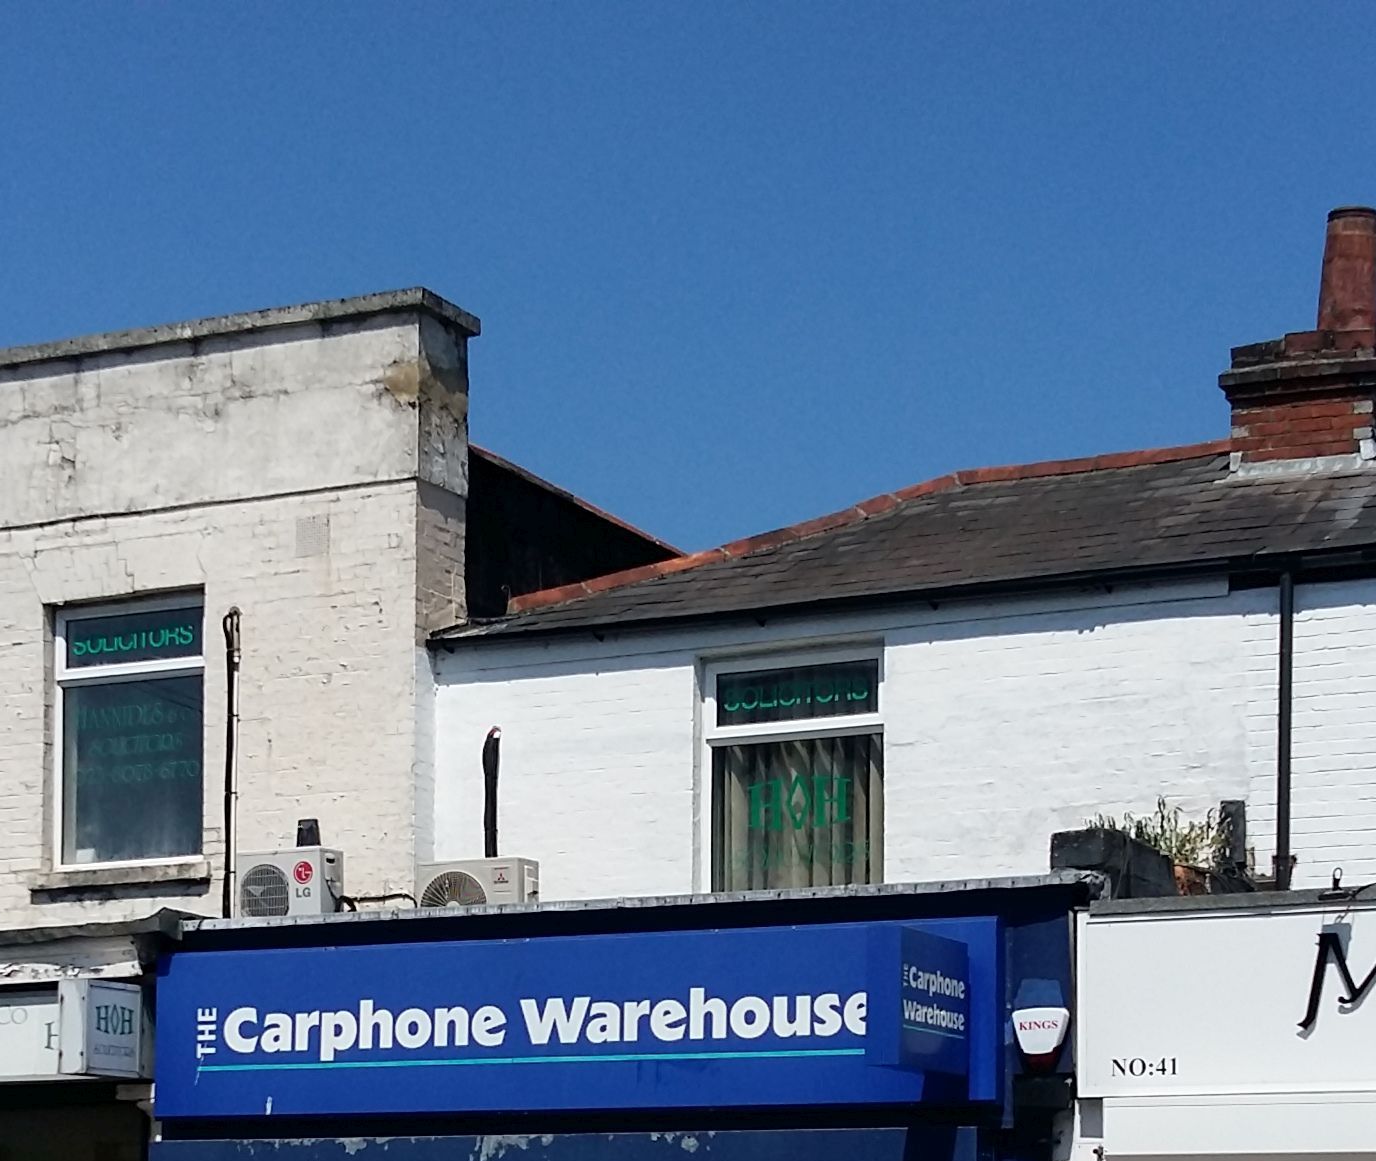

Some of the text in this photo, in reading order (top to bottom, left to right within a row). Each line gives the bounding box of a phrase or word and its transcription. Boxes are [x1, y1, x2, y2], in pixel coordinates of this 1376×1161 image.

[295, 887, 312, 899] LG
[909, 965, 966, 999] Carphone
[197, 987, 868, 1062] THE Carphone Warehouse
[902, 999, 966, 1032] Warehouse
[1018, 1019, 1060, 1032] KINGS
[1110, 1056, 1179, 1077] NO:41
